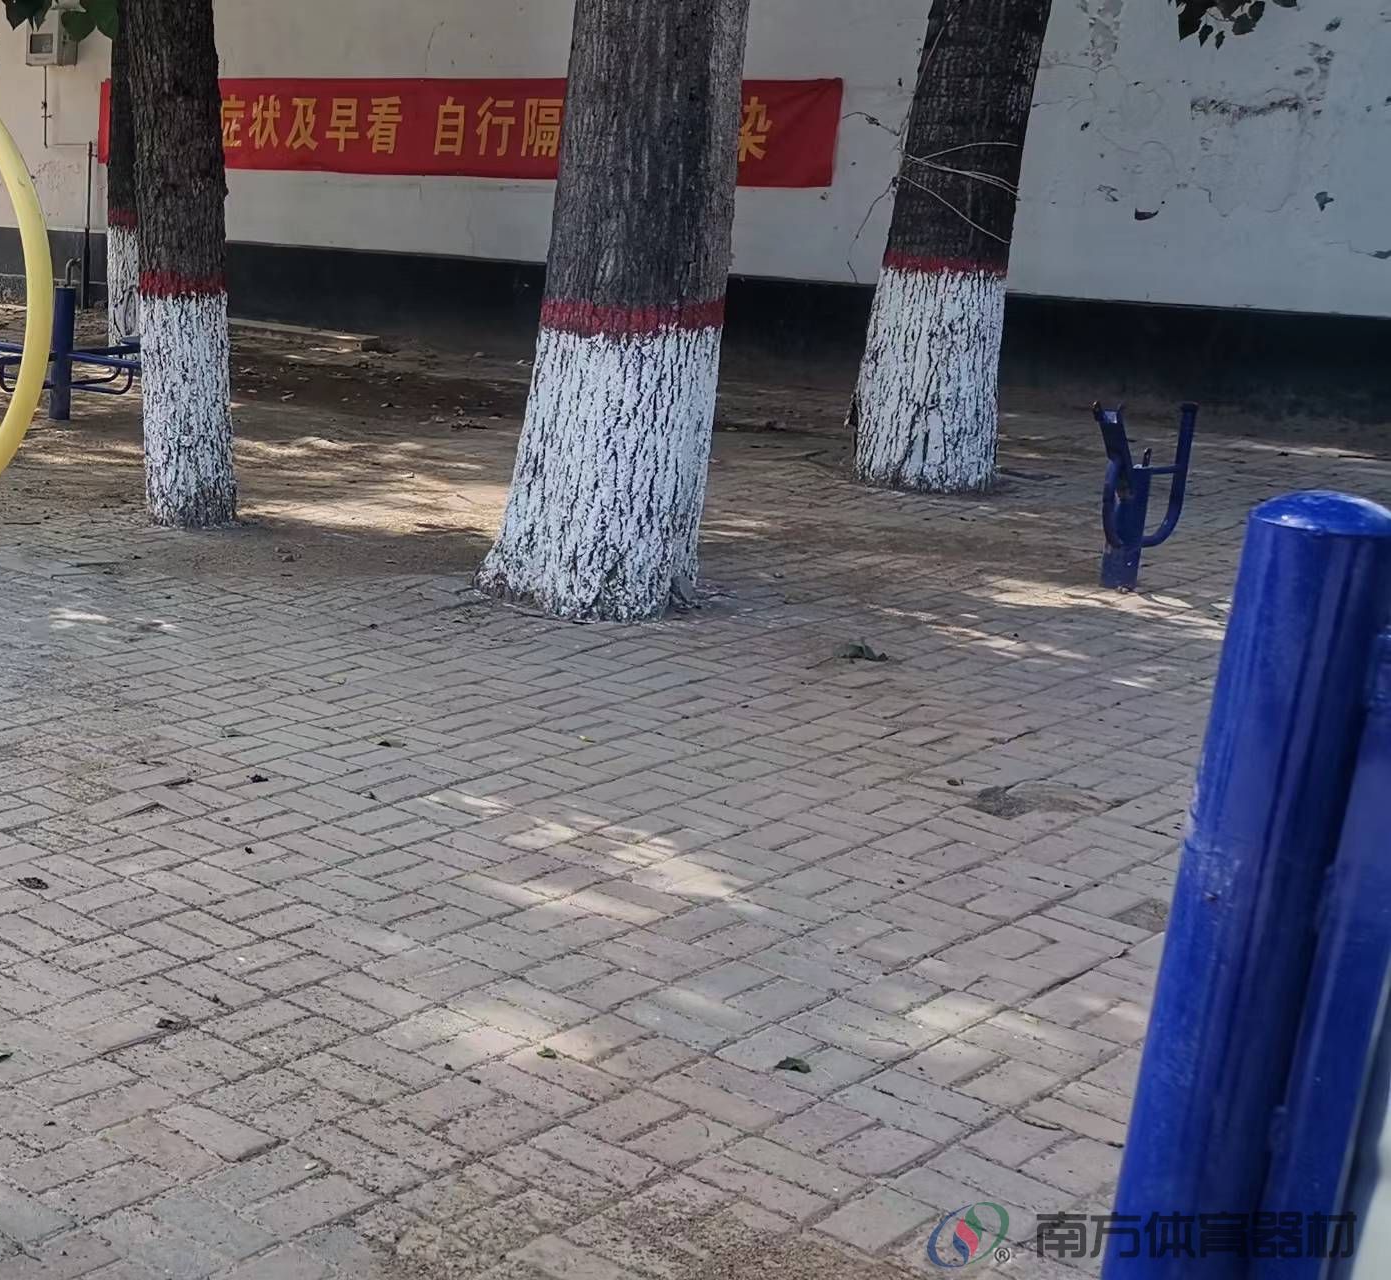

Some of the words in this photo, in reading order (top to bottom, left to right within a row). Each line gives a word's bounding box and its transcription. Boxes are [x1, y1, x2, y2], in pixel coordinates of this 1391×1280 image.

[220, 94, 403, 155] 症状及早看
